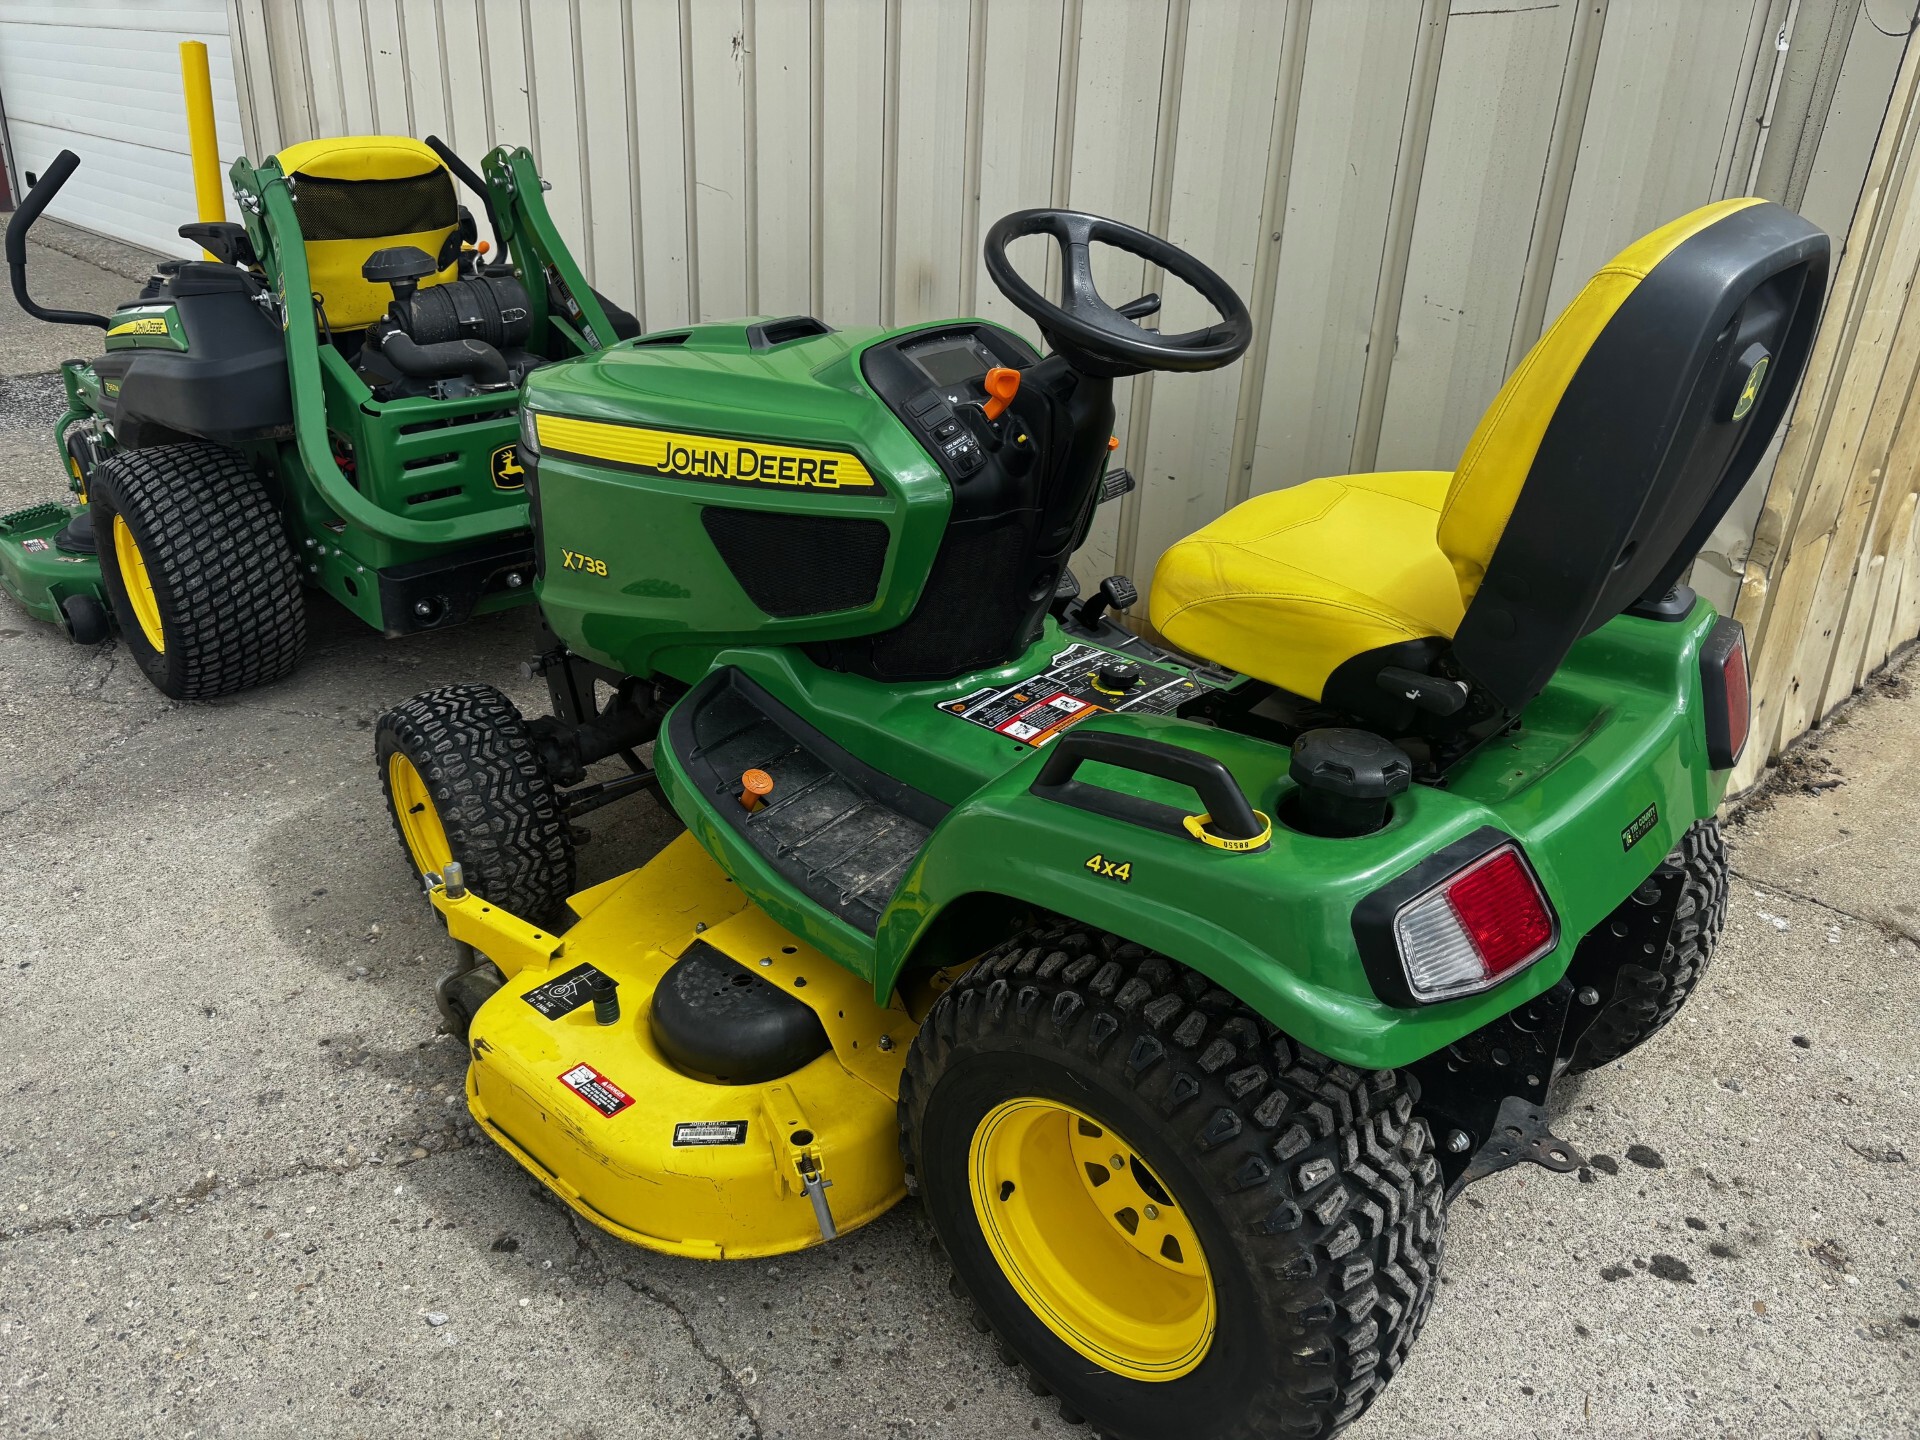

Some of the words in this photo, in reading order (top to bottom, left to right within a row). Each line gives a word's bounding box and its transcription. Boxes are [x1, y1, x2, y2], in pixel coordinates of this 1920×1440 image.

[146, 321, 163, 333] DEERE
[657, 441, 729, 475] JOHN
[736, 447, 839, 485] DEERE
[561, 548, 608, 577] X738
[1639, 806, 1656, 827] COUNTY
[1085, 854, 1131, 881] 4x4
[606, 1083, 626, 1099] DANGER
